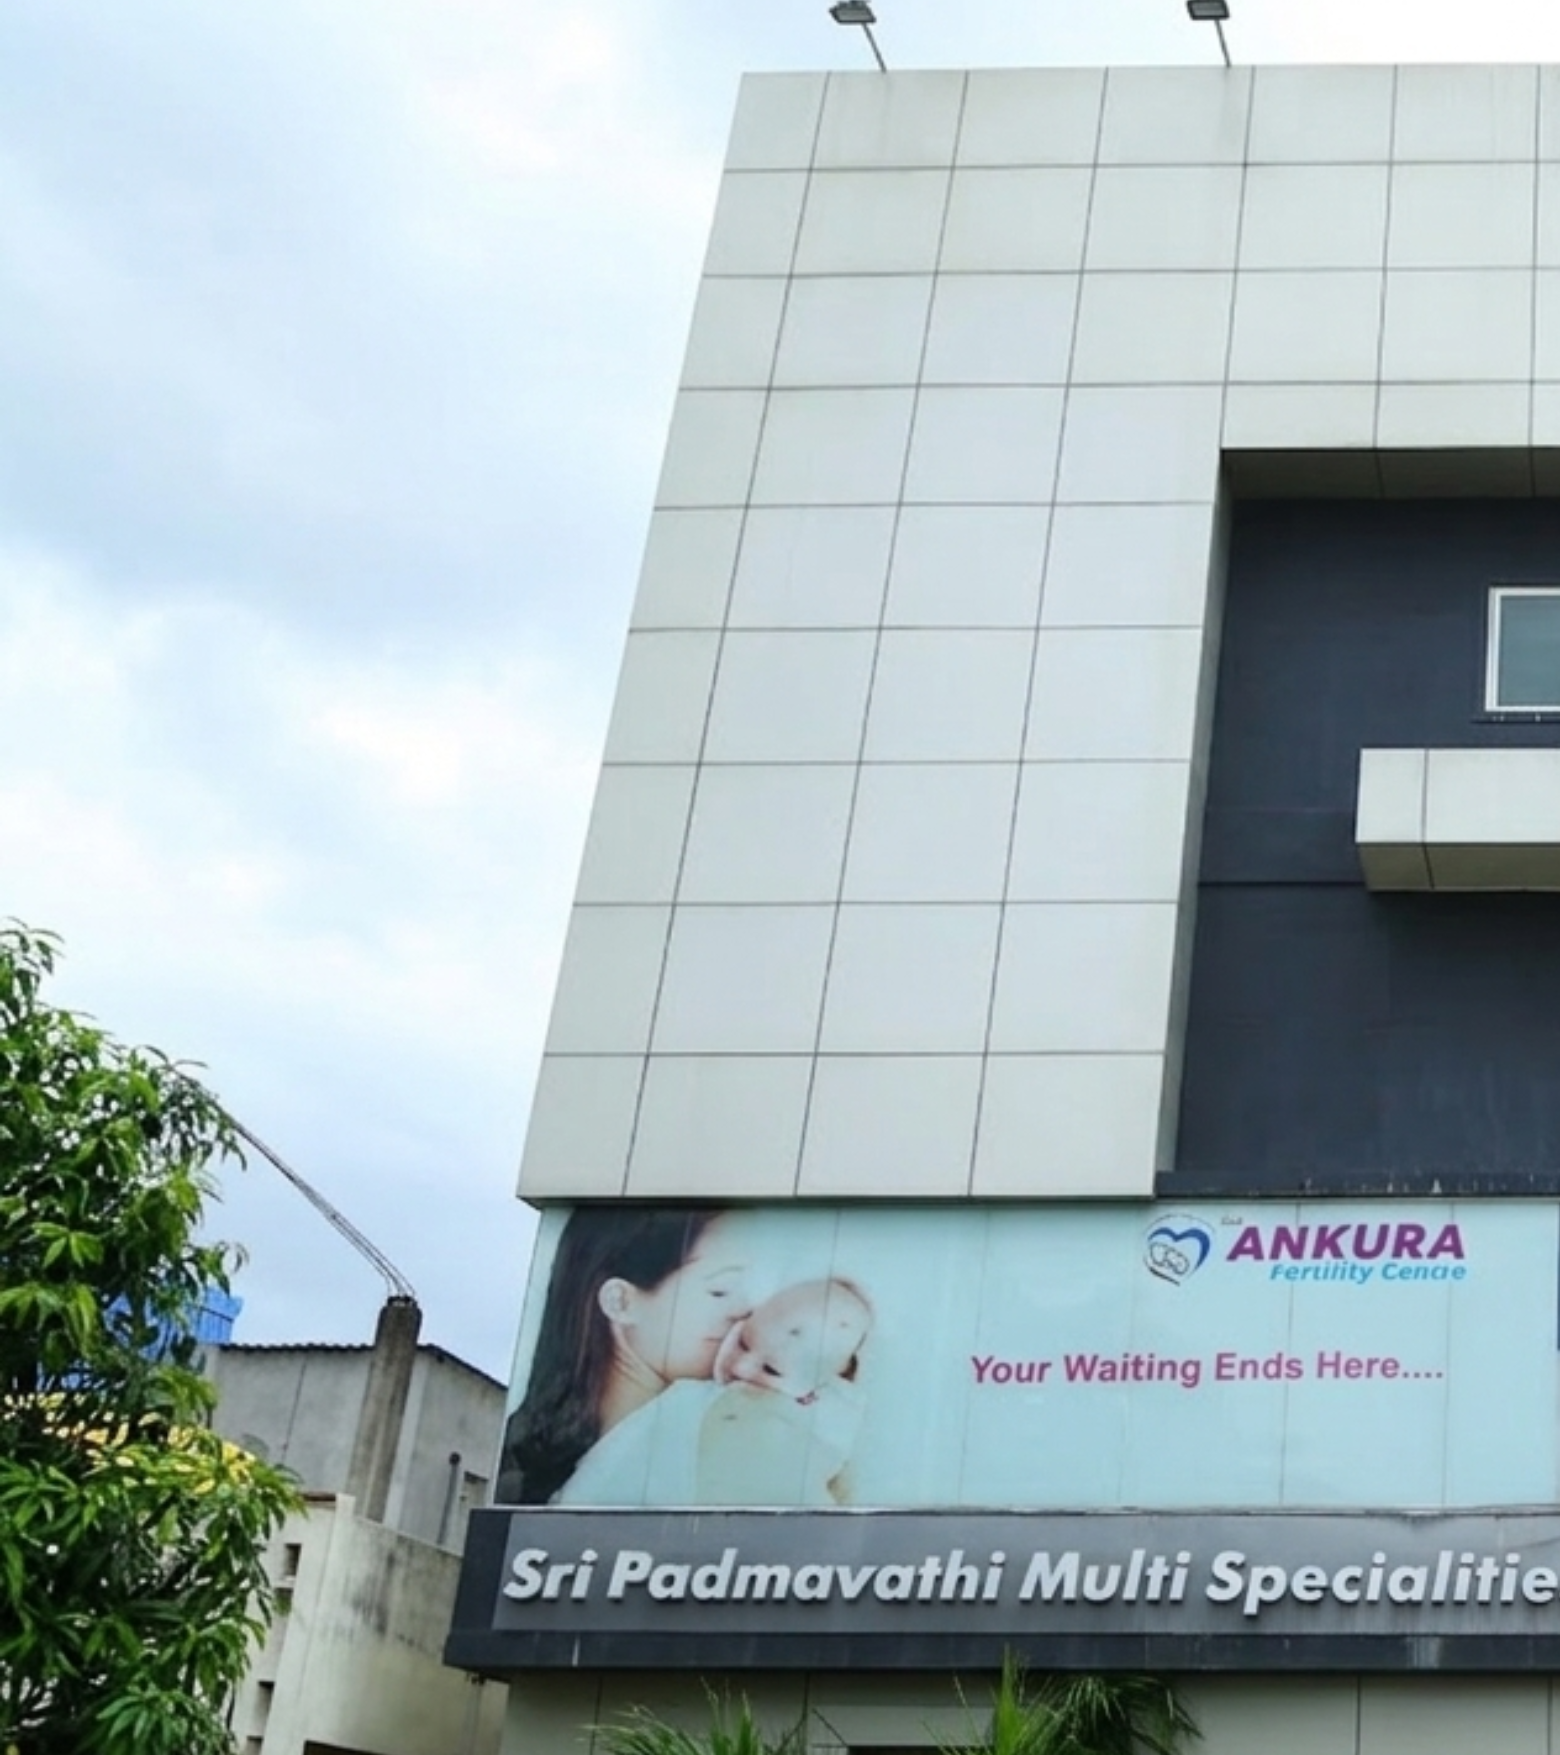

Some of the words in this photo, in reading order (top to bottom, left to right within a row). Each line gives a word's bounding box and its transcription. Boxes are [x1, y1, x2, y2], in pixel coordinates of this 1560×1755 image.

[1226, 1223, 1465, 1261] ANKURA
[1270, 1261, 1374, 1285] Fertility
[971, 1355, 1051, 1384] Your
[1064, 1352, 1201, 1388] Waiting
[1214, 1351, 1304, 1381] Ends
[503, 1548, 598, 1601] Sri
[606, 1548, 1006, 1601] Padmavathi
[1018, 1549, 1191, 1601] Multi
